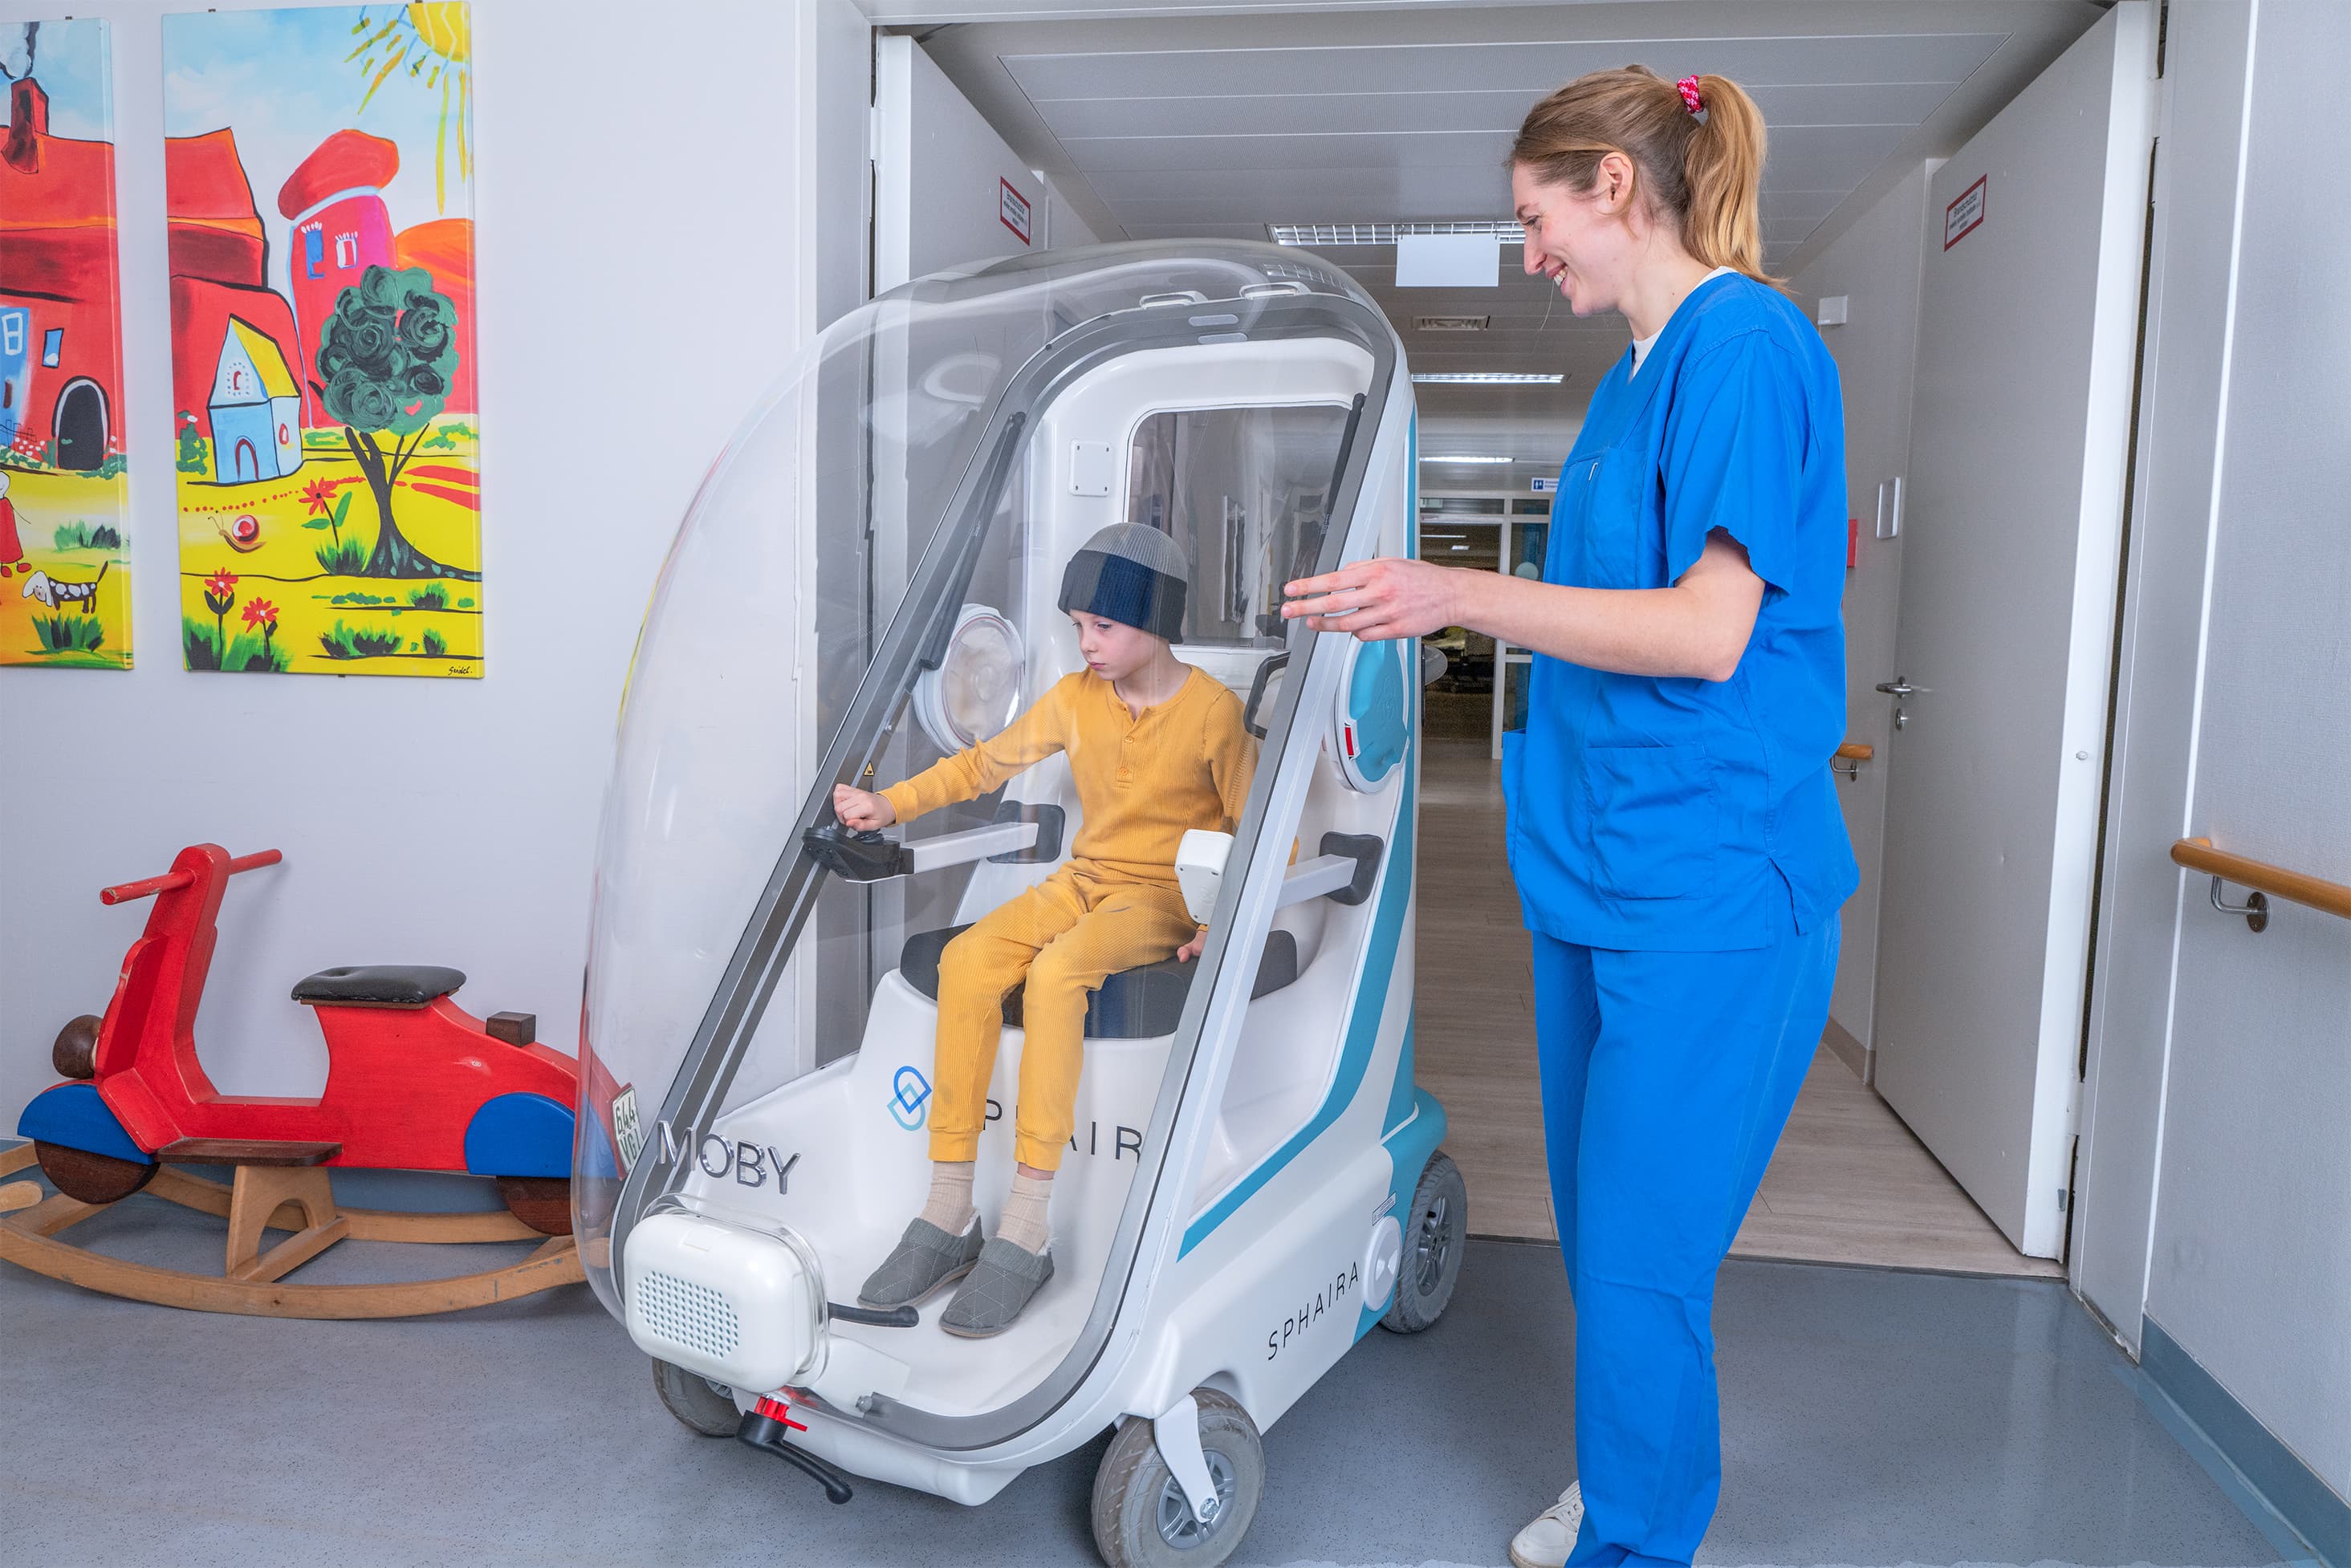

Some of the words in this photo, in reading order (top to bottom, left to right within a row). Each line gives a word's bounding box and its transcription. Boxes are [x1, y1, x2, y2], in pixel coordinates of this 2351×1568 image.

[616, 1096, 636, 1135] 644
[657, 1119, 801, 1195] MOBY
[1267, 1261, 1359, 1361] SPHAIRA
